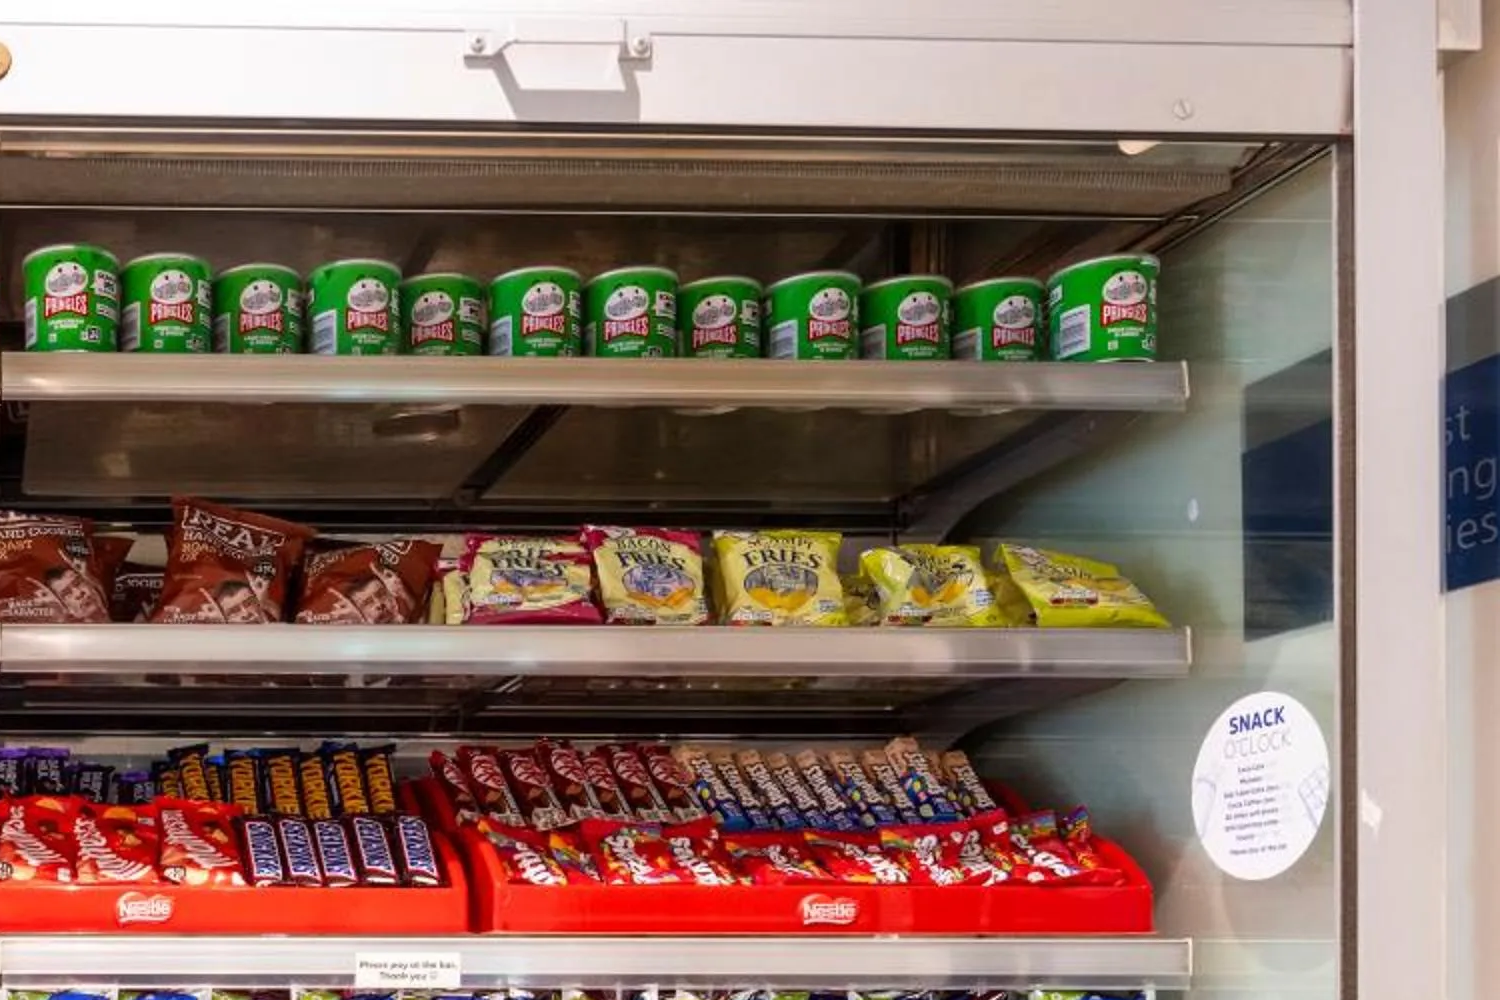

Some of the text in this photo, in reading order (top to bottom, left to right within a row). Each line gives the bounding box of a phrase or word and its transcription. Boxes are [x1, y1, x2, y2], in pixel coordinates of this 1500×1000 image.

[45, 294, 87, 316] PRINGLES
[151, 303, 193, 322] PRINGLES
[1103, 303, 1146, 323] PRINGLES
[347, 310, 388, 330] PRINGLES
[522, 316, 565, 335] PRINGLES
[604, 319, 648, 339] PRINGLES
[693, 325, 736, 345] PRINGLES
[617, 539, 671, 553] BACON
[180, 552, 198, 562] OX
[614, 550, 686, 571] FRIES
[741, 549, 822, 569] FRIES
[1229, 706, 1286, 734] SNACK
[269, 756, 299, 814] YORKIE
[301, 756, 331, 819] YORKIE
[247, 822, 280, 879] SNICKERS
[117, 892, 174, 922] Nestlé
